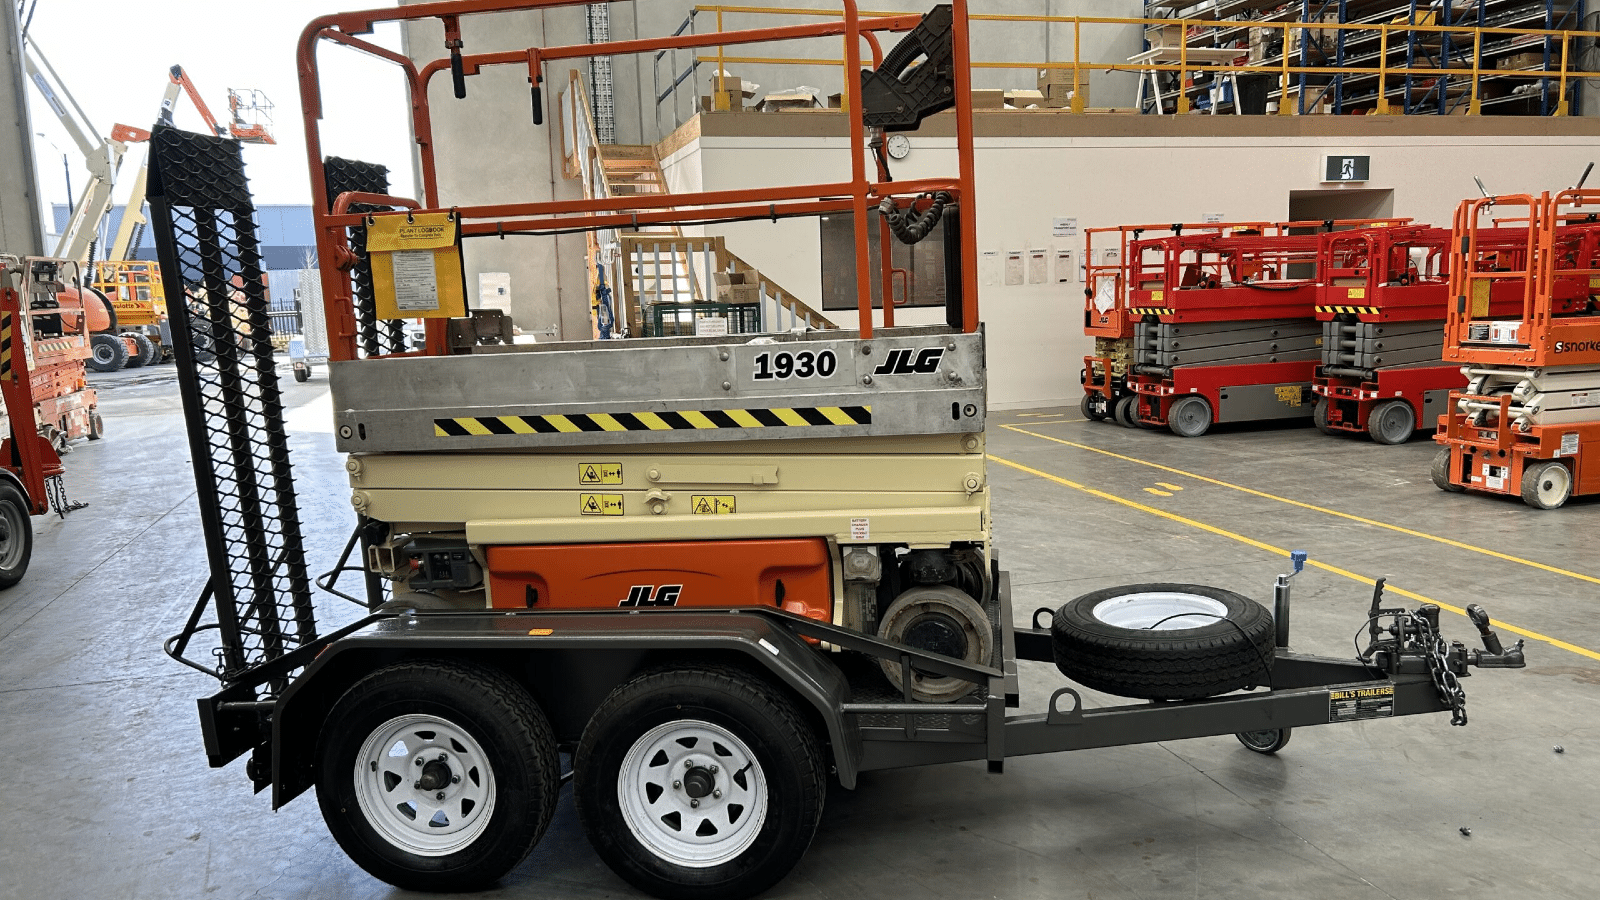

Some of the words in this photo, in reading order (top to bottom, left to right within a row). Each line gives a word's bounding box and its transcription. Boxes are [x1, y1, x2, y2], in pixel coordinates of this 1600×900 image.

[753, 350, 837, 381] 1930
[873, 347, 946, 375] JLG
[618, 584, 683, 606] JLG
[1335, 690, 1356, 699] BILL'S
[1357, 688, 1389, 697] TRAILERS
